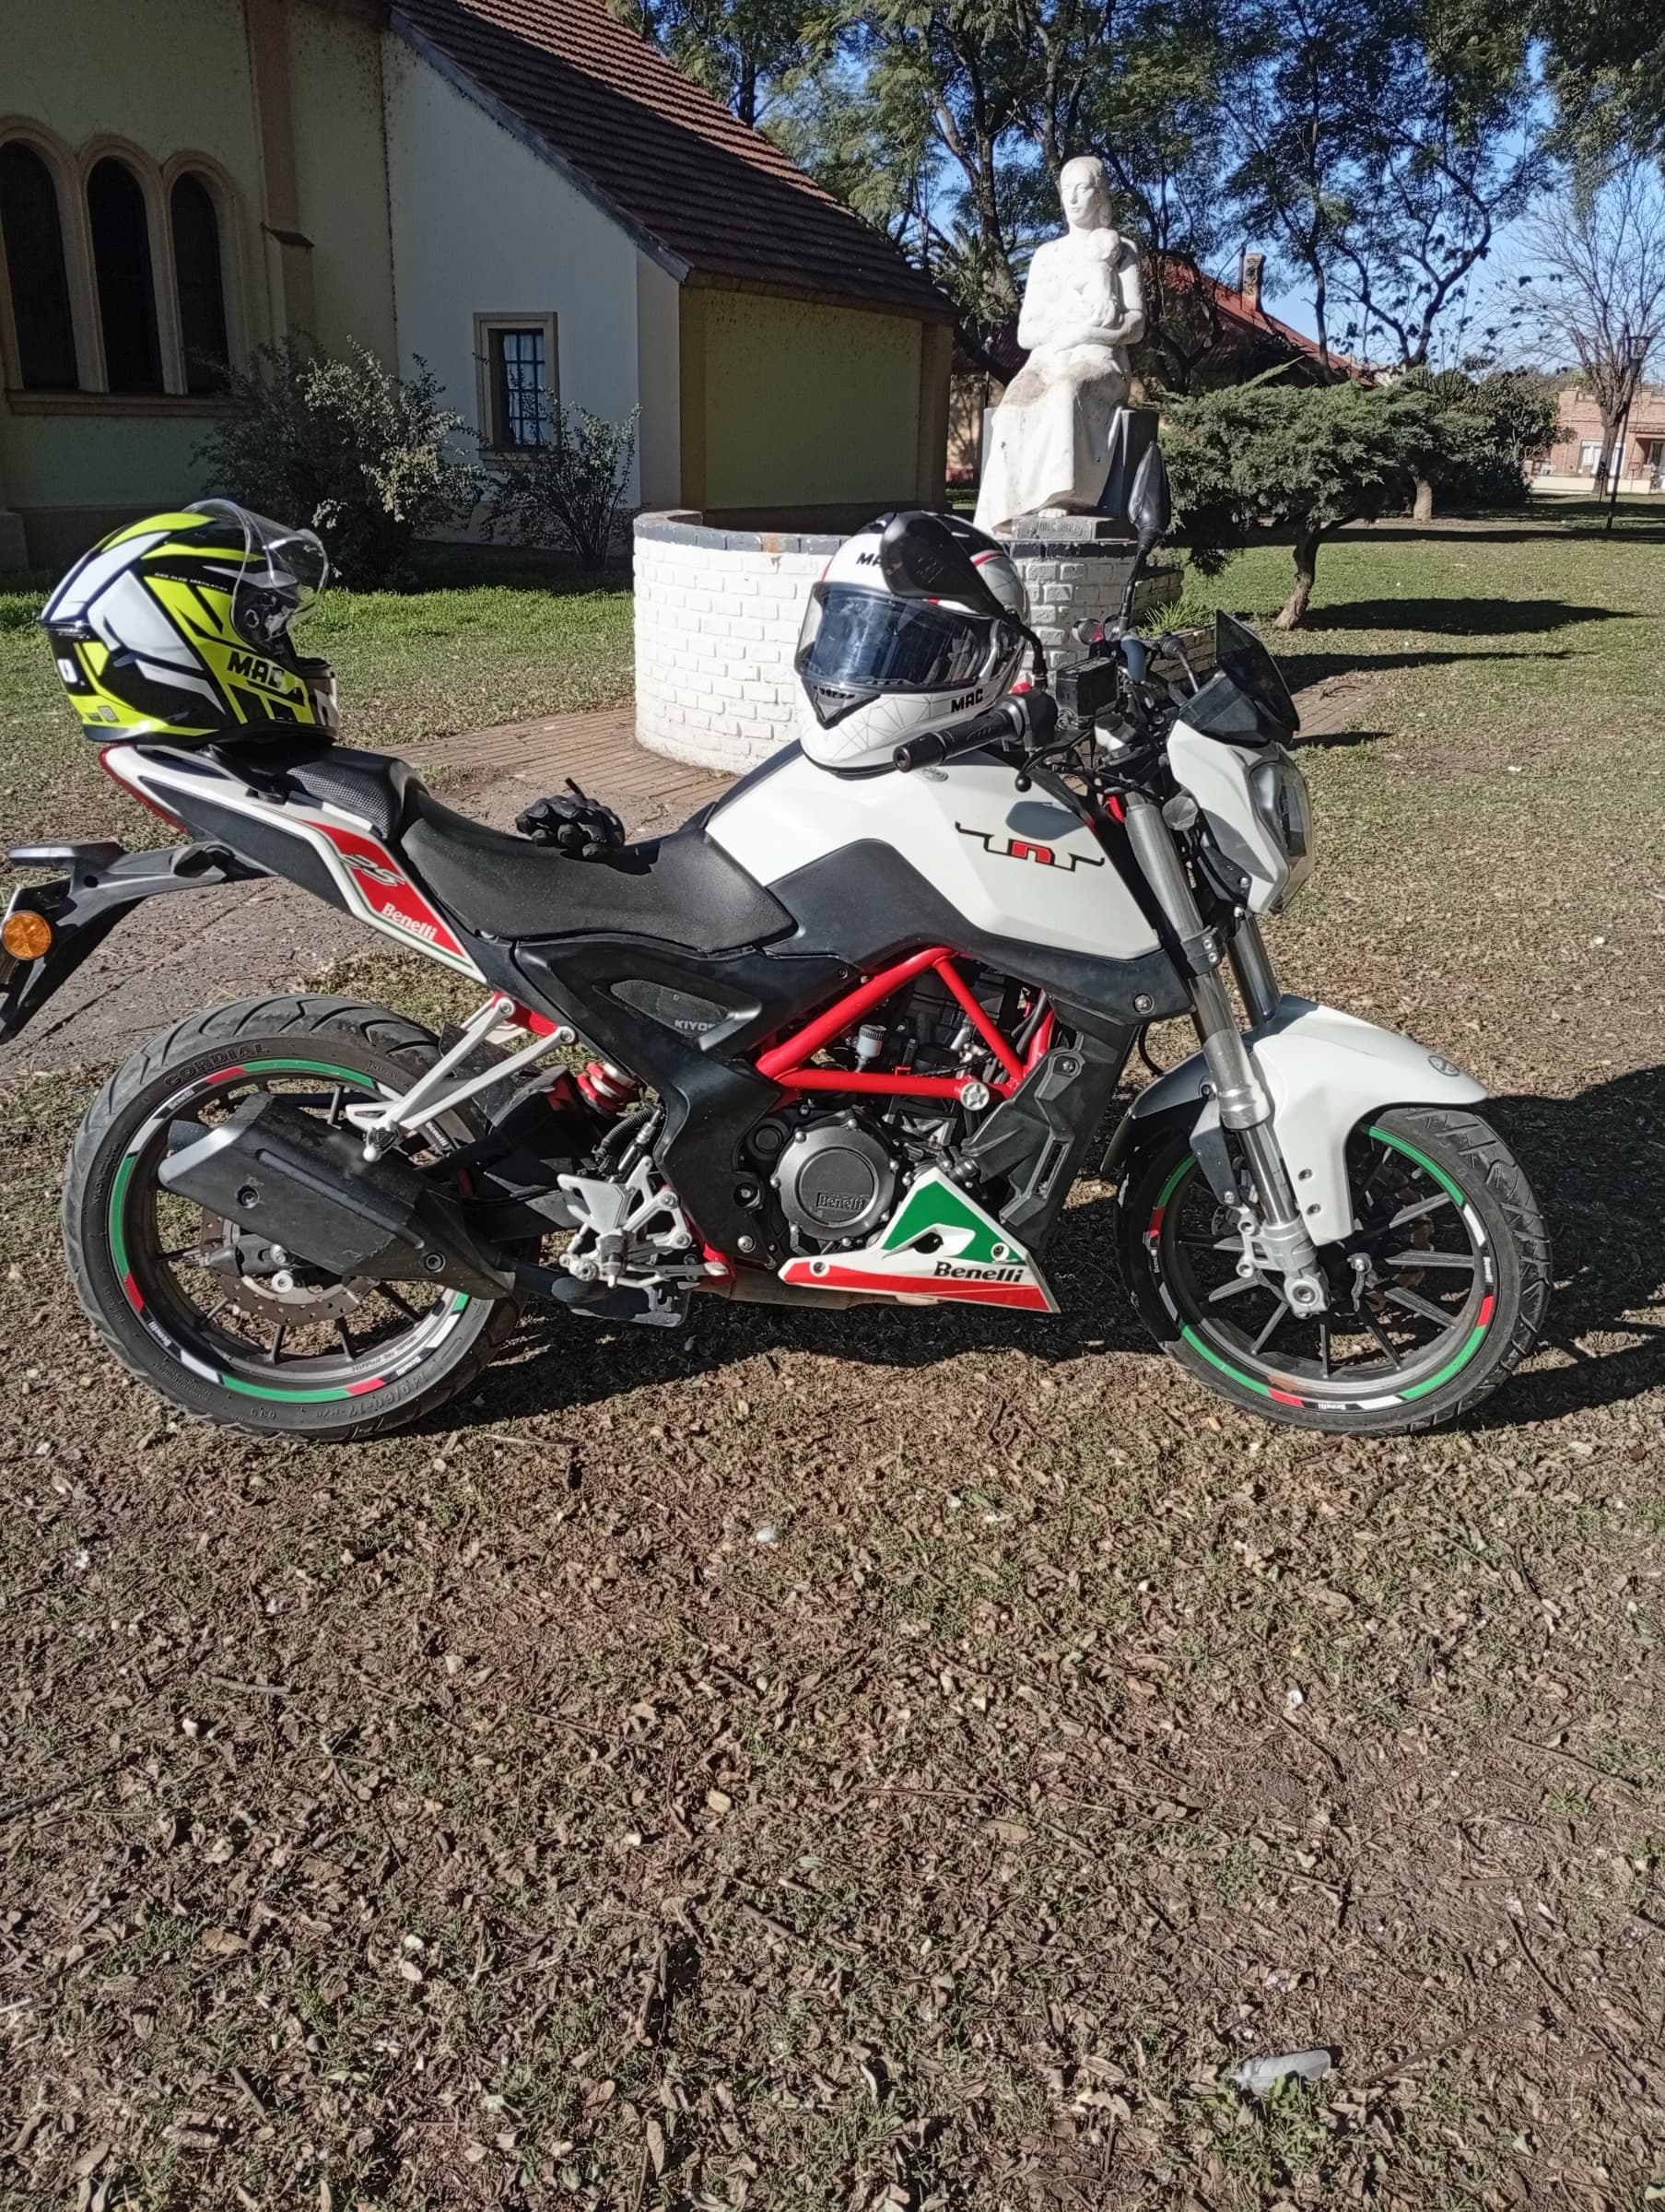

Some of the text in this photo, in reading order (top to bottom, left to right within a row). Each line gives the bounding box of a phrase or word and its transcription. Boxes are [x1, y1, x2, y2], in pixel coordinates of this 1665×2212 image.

[227, 651, 285, 688] MAC
[951, 688, 983, 712] MAC
[381, 902, 438, 940] Benelli
[164, 1043, 270, 1086] CORDIAL
[816, 1193, 864, 1210] Benelli
[933, 1261, 1024, 1282] Benelli
